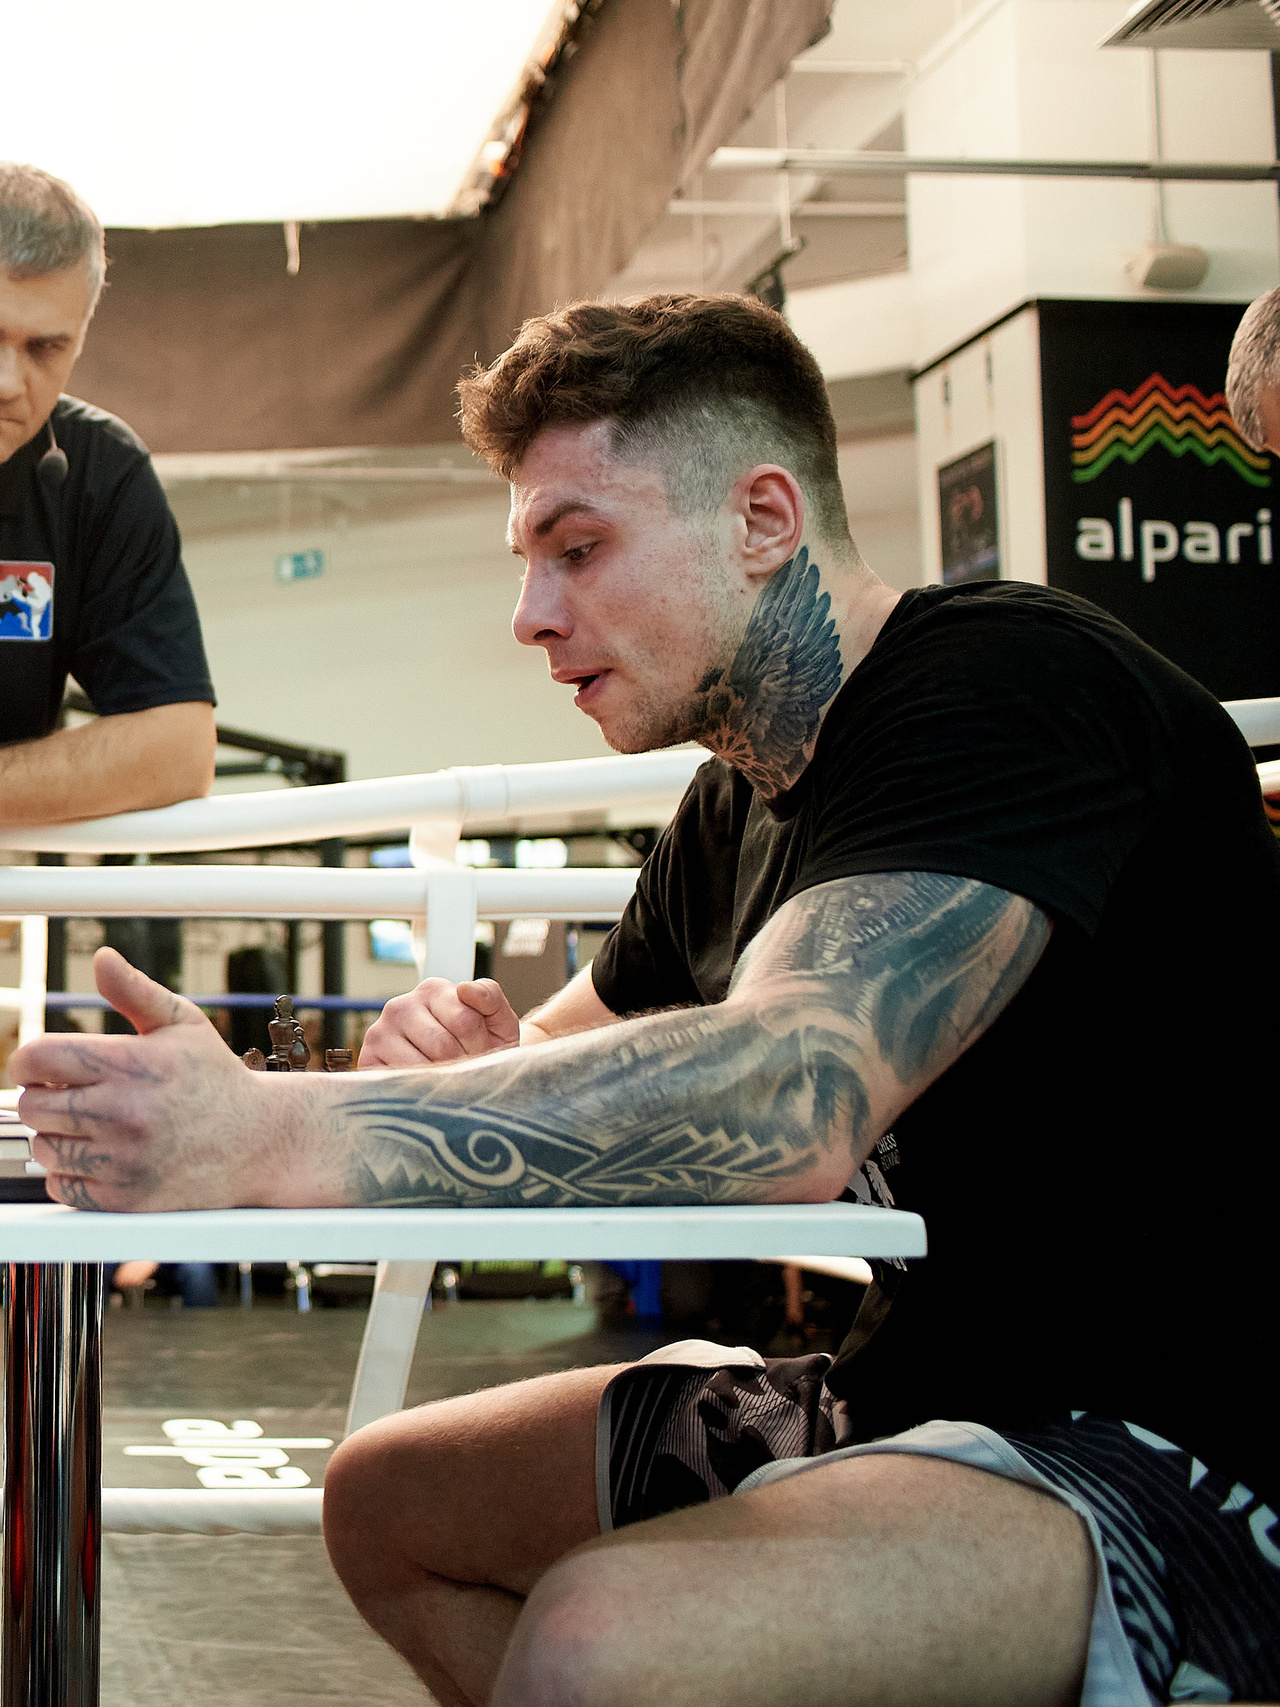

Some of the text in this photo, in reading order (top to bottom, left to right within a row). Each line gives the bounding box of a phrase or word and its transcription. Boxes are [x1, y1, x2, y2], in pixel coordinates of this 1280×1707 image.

[1075, 497, 1272, 583] alpari
[876, 1133, 897, 1154] CHESS
[123, 1418, 334, 1489] alpa
